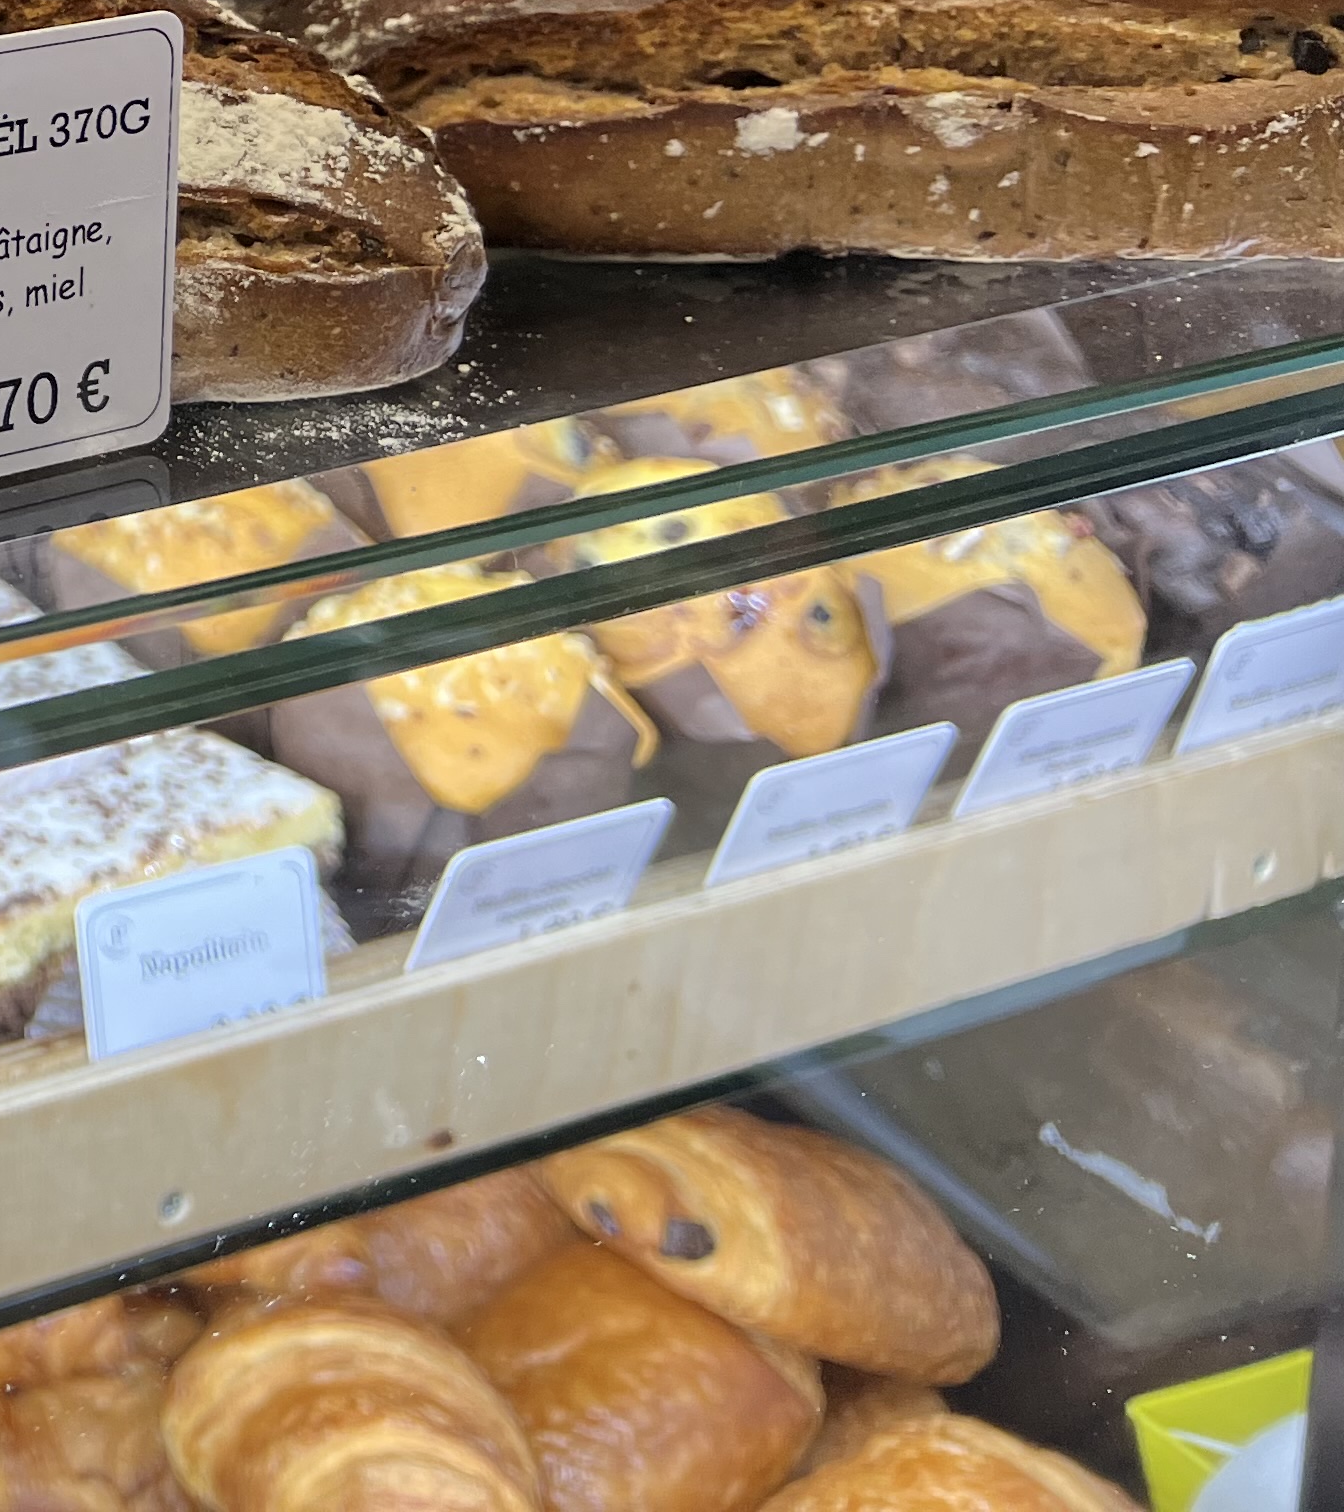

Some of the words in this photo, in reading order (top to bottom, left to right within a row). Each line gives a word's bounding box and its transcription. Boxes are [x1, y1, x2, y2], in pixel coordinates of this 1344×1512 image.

[48, 97, 152, 149] 370G
[24, 266, 85, 308] miel
[76, 358, 110, 414] €
